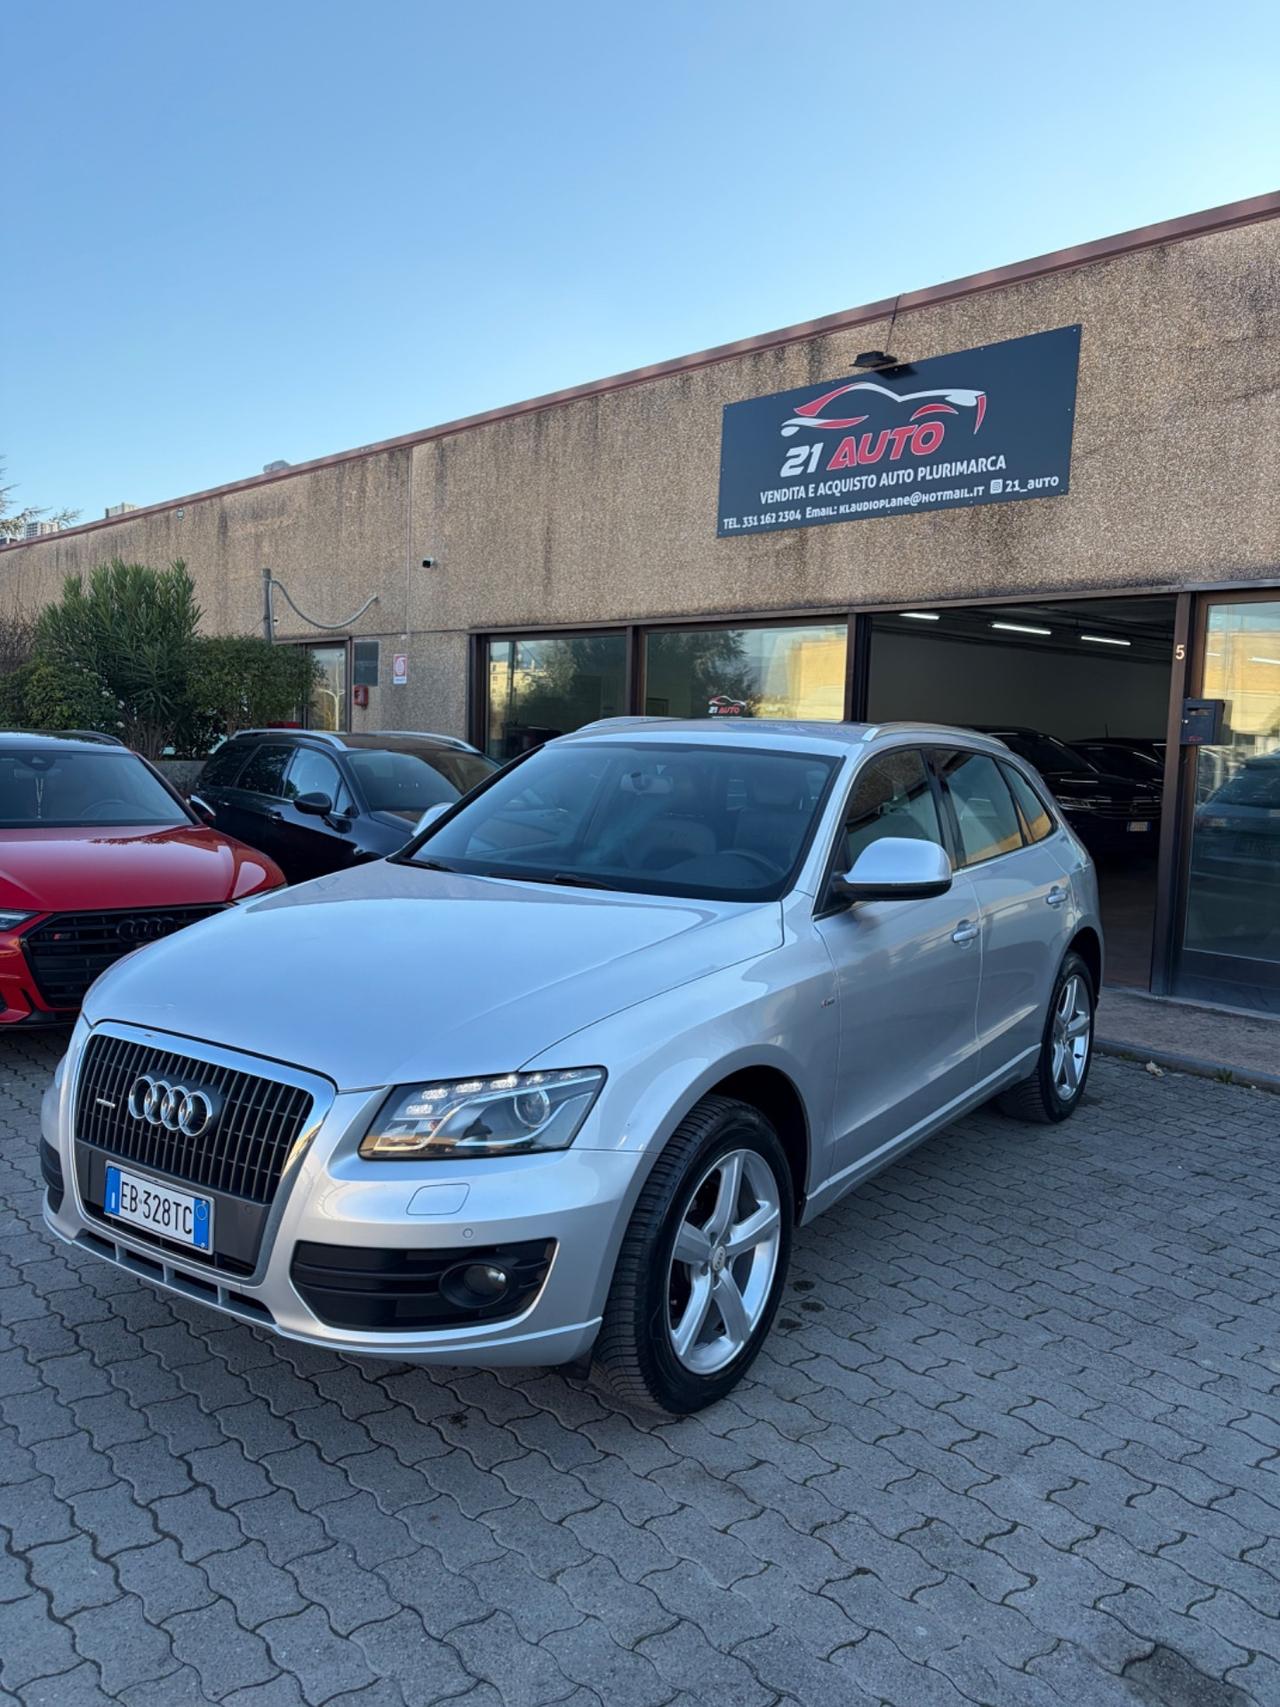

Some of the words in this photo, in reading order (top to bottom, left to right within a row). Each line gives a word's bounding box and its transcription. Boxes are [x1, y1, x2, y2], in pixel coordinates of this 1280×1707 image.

[780, 442, 824, 478] 21
[826, 421, 945, 471] AUTO
[760, 485, 806, 505] VENDITA
[808, 484, 815, 497] E
[816, 474, 877, 497] ACQUISTO
[879, 468, 914, 487] AUTO
[917, 454, 1006, 482] PLURIMARCA
[723, 517, 740, 530] TEL.
[742, 514, 758, 529] 331
[760, 512, 776, 526] 162
[778, 509, 802, 523] 2304
[1175, 644, 1185, 660] 5
[719, 705, 740, 714] AUTO
[121, 1181, 139, 1213] EB
[142, 1190, 192, 1234] 328TC
